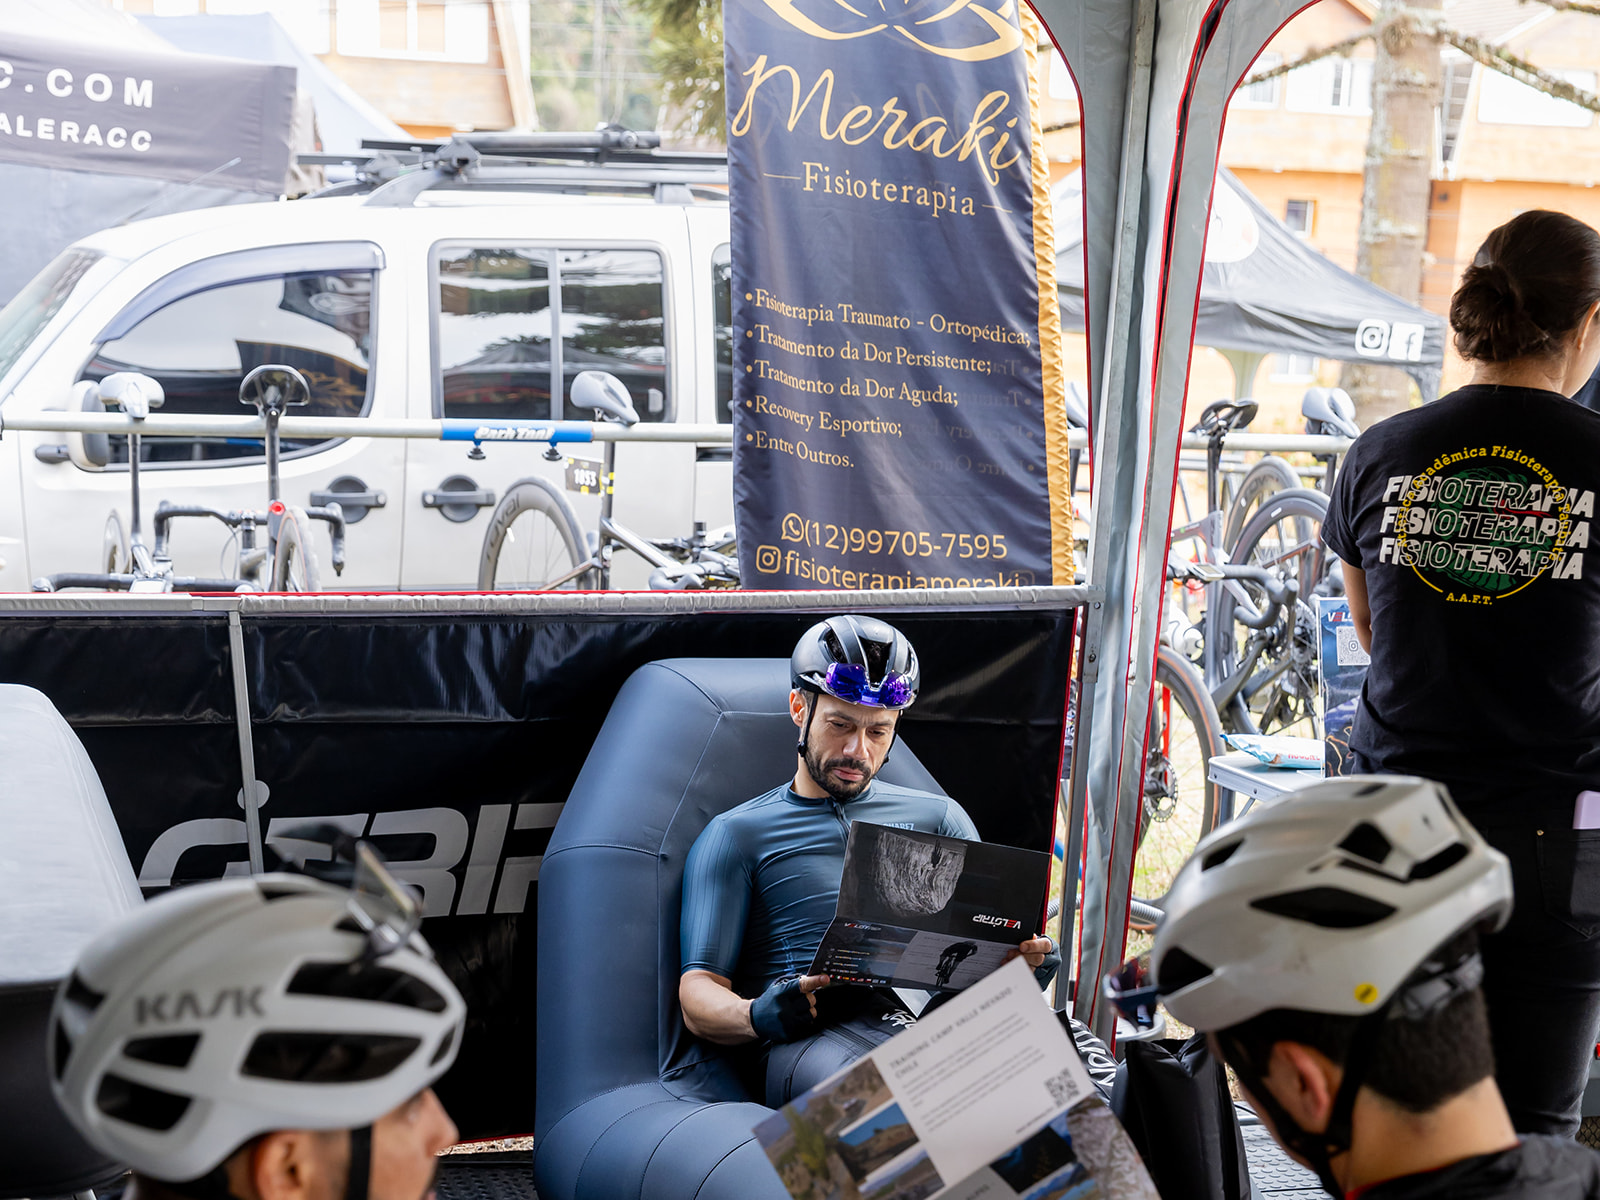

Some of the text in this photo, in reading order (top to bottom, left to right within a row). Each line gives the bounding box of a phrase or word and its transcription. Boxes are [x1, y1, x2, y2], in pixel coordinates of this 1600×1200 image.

[731, 54, 1021, 186] Meraki
[802, 161, 976, 218] Fisioterapia
[754, 288, 834, 327] Fisioterapia
[837, 303, 910, 330] Traumato
[930, 313, 1031, 348] Ortopédica;
[754, 324, 835, 358] Tratamento
[840, 341, 860, 360] da
[863, 342, 893, 363] Dor
[894, 346, 991, 376] Persistente;
[754, 359, 835, 395] Tratamento
[839, 377, 861, 396] da
[865, 378, 895, 399] Dor
[899, 382, 959, 407] Aguda;
[755, 395, 814, 432] Recovery
[819, 411, 903, 438] Esportivo;
[755, 431, 854, 468] Entre Outros.
[1382, 475, 1595, 518] FISIOTERAPIA
[805, 519, 1008, 559] (12)99705-7595
[1379, 507, 1590, 549] FISIOTERAPIA
[1378, 537, 1584, 580] FISIOTERAPIA
[1446, 592, 1494, 606] A.A.F.T.
[972, 912, 1022, 930] VELOTRIP
[134, 985, 266, 1026] KASK
